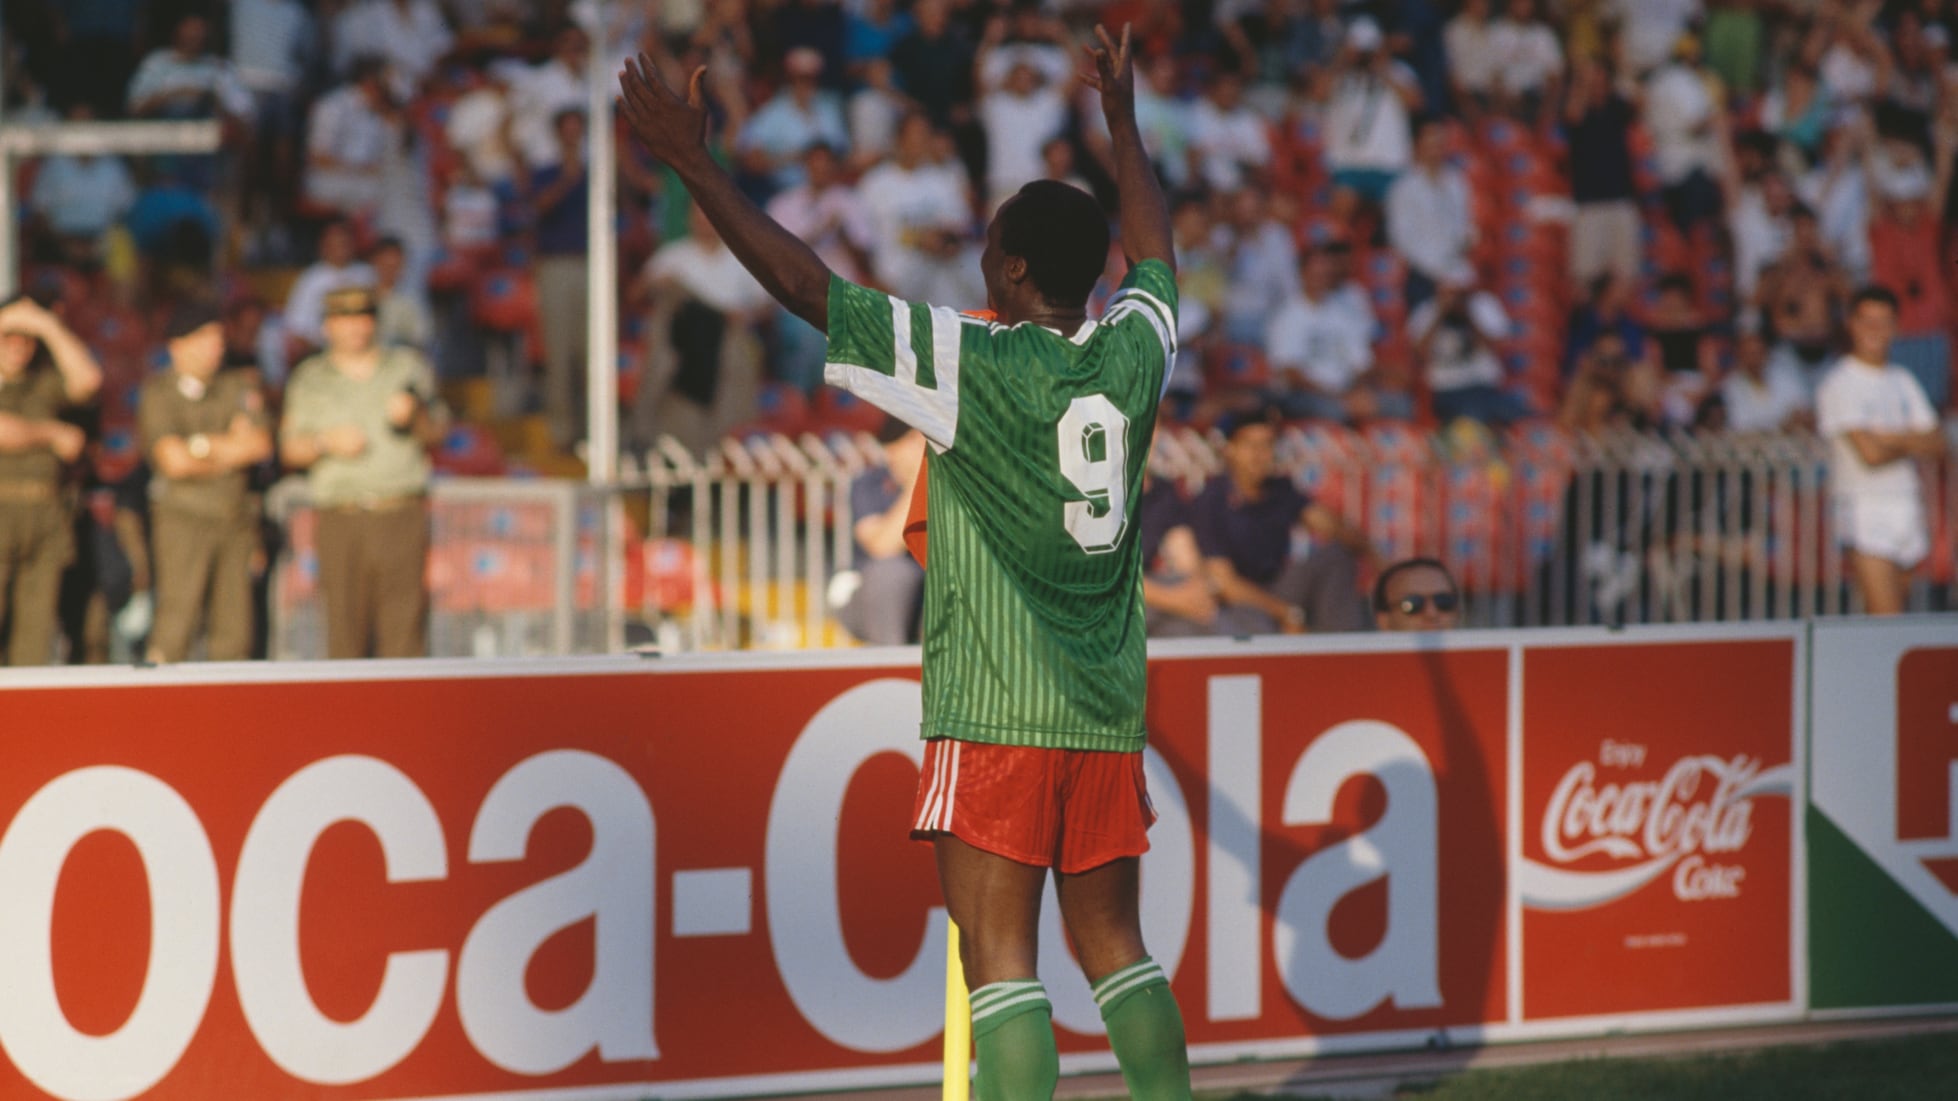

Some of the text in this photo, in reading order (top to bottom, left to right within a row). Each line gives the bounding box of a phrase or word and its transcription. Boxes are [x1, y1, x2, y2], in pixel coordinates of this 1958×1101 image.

[1057, 393, 1130, 555] 9
[1600, 739, 1647, 769] Enjoy
[1673, 855, 1746, 901] Coke
